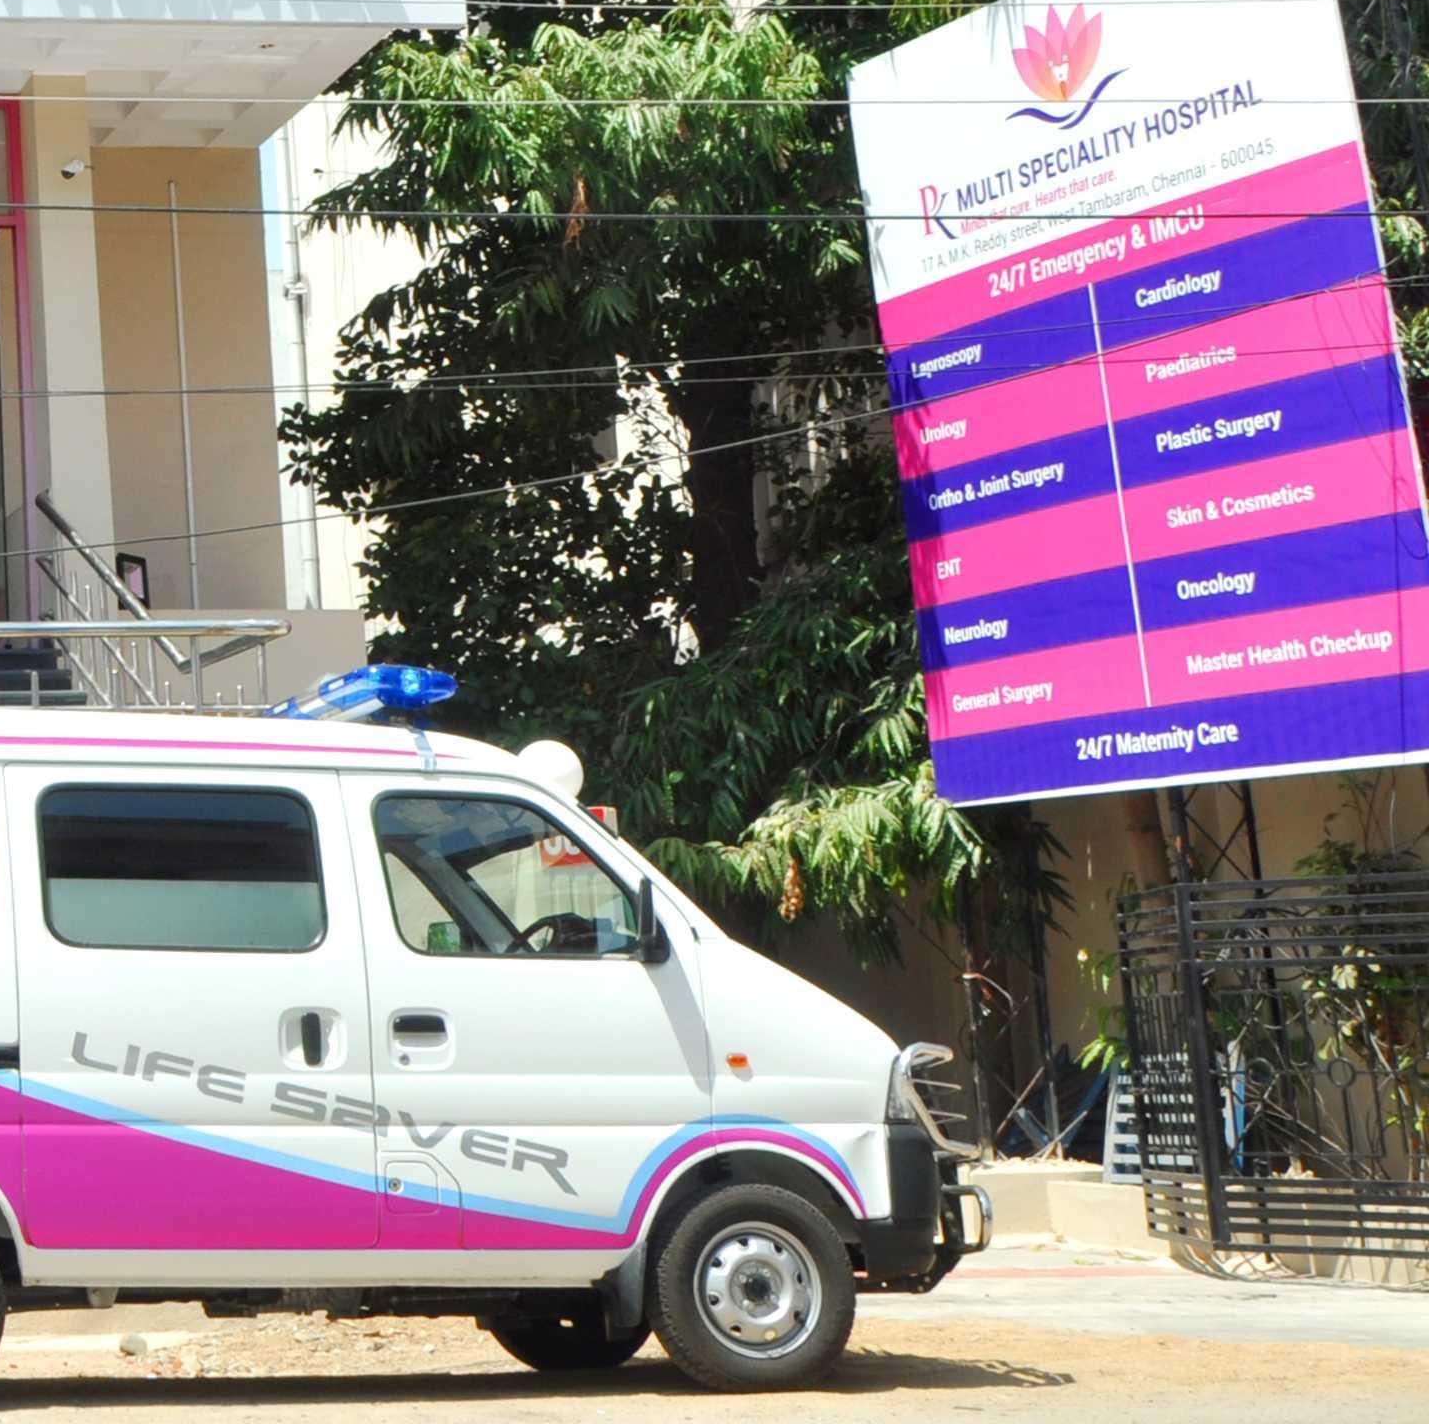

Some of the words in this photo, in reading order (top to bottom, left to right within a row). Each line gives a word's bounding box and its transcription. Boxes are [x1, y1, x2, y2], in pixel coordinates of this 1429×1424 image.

[956, 168, 1014, 212] MULTI
[1018, 121, 1137, 189] SPECIALITY
[1143, 79, 1263, 143] HOSPITAL
[974, 231, 1008, 256] Reddy
[1151, 163, 1207, 193] Chennai
[1034, 187, 1067, 208] Hearts
[1069, 175, 1090, 196] that
[987, 262, 1027, 297] 24/7
[1029, 234, 1127, 283] Emergency
[1130, 224, 1147, 249] &
[1148, 204, 1205, 244] IMCU
[1135, 269, 1222, 307] Cardiology
[911, 344, 982, 379] Laproscopy
[1145, 345, 1237, 383] Paediatrics
[920, 419, 968, 444] Urology
[1155, 424, 1213, 453] Plastic
[1214, 410, 1283, 439] Surgery
[929, 487, 965, 511] Ortho
[964, 483, 976, 502] &
[977, 475, 1011, 498] Joint
[1011, 462, 1065, 489] Surgery
[1167, 505, 1204, 528] Skin
[1205, 500, 1219, 521] &
[1221, 483, 1316, 517] Cosmetics
[936, 557, 962, 580] ENT
[1176, 572, 1256, 601] Oncology
[944, 619, 1008, 645] Neurology
[1186, 650, 1244, 676] Master
[1247, 639, 1307, 666] Health
[1310, 629, 1393, 657] Checkup
[952, 686, 1001, 712] General
[1001, 682, 1053, 705] Surgery
[1075, 734, 1113, 762] 24/7
[1115, 725, 1195, 756] Maternity
[1196, 722, 1239, 745] Care
[69, 1031, 247, 1104] LIFE
